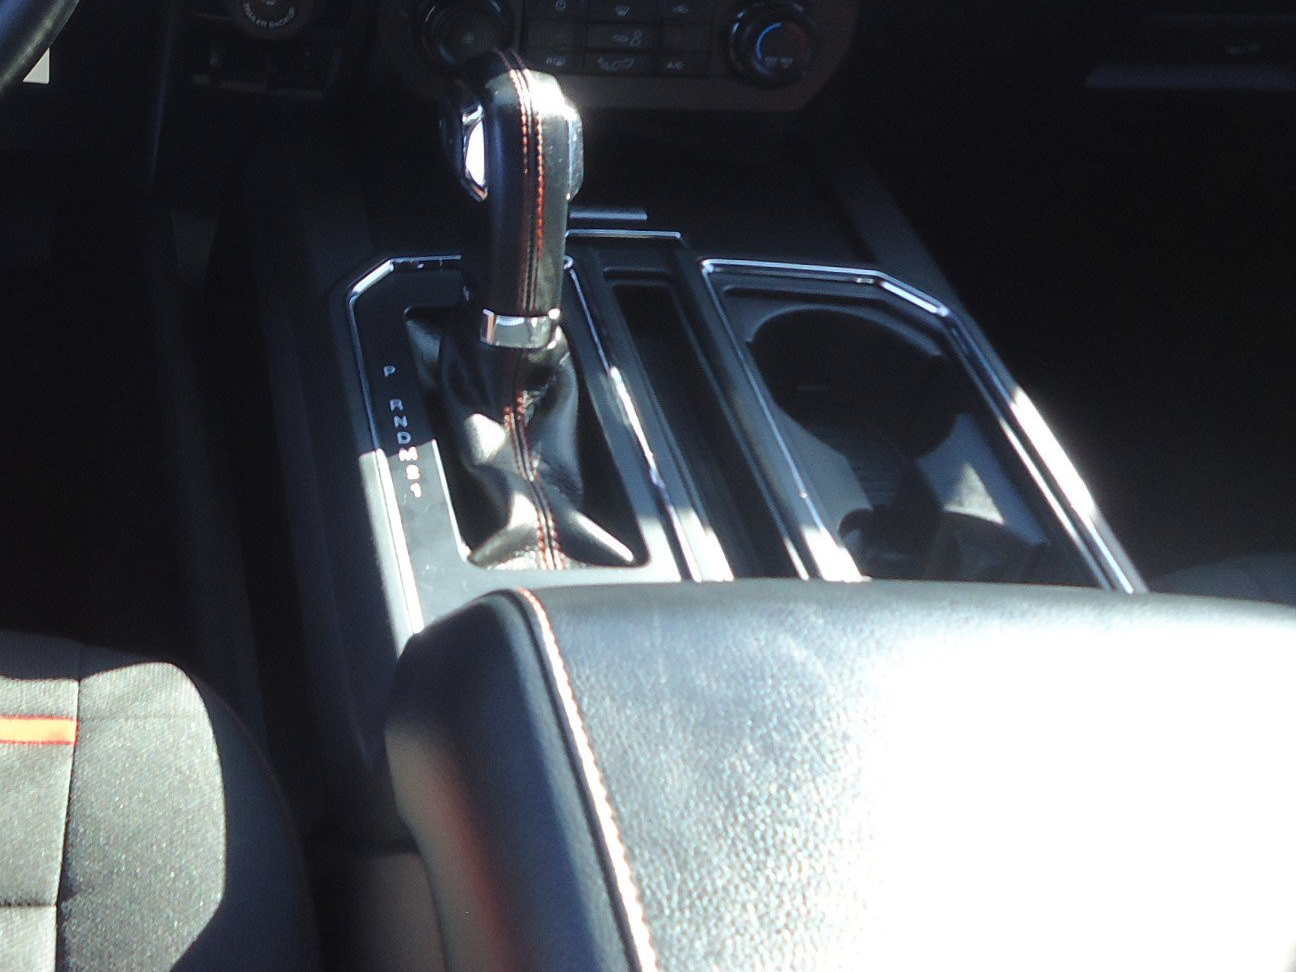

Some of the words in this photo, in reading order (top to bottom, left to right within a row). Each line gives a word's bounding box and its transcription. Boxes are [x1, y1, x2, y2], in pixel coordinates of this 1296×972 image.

[383, 365, 396, 377] P
[393, 415, 408, 428] N
[397, 431, 411, 444] D
[398, 446, 418, 462] M
